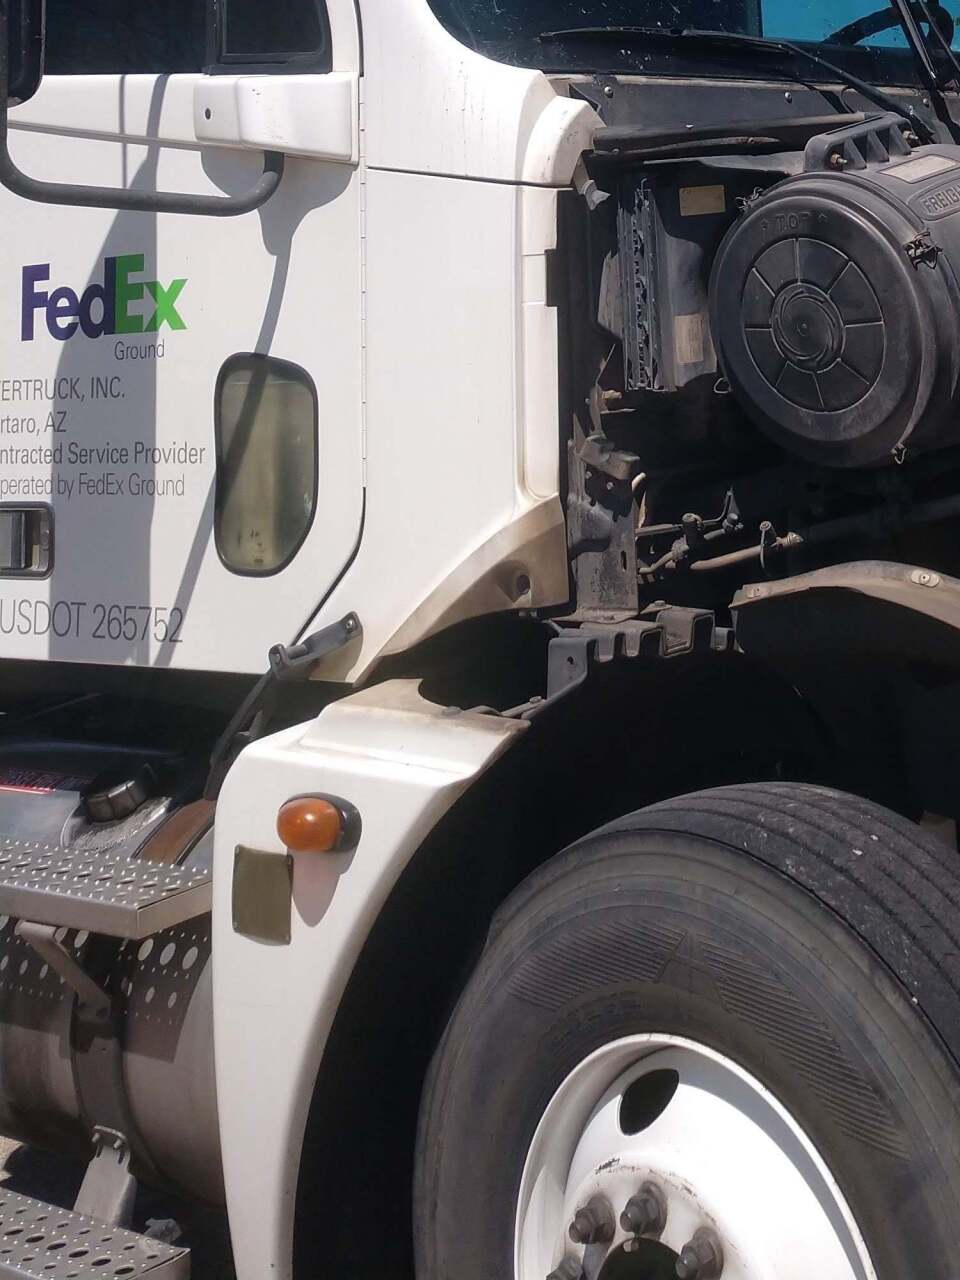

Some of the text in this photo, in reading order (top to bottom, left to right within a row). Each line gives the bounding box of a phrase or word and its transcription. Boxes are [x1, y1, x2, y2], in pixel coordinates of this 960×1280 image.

[21, 253, 188, 342] FedEx
[114, 339, 165, 361] Ground
[0, 376, 125, 402] ERTRUCK, INC.
[44, 411, 67, 432] AZ
[68, 441, 129, 464] Service
[134, 441, 206, 464] Provider
[57, 472, 75, 500] by
[78, 472, 124, 495] FedEx
[128, 472, 185, 496] Ground
[0, 599, 184, 643] USDOT 265752
